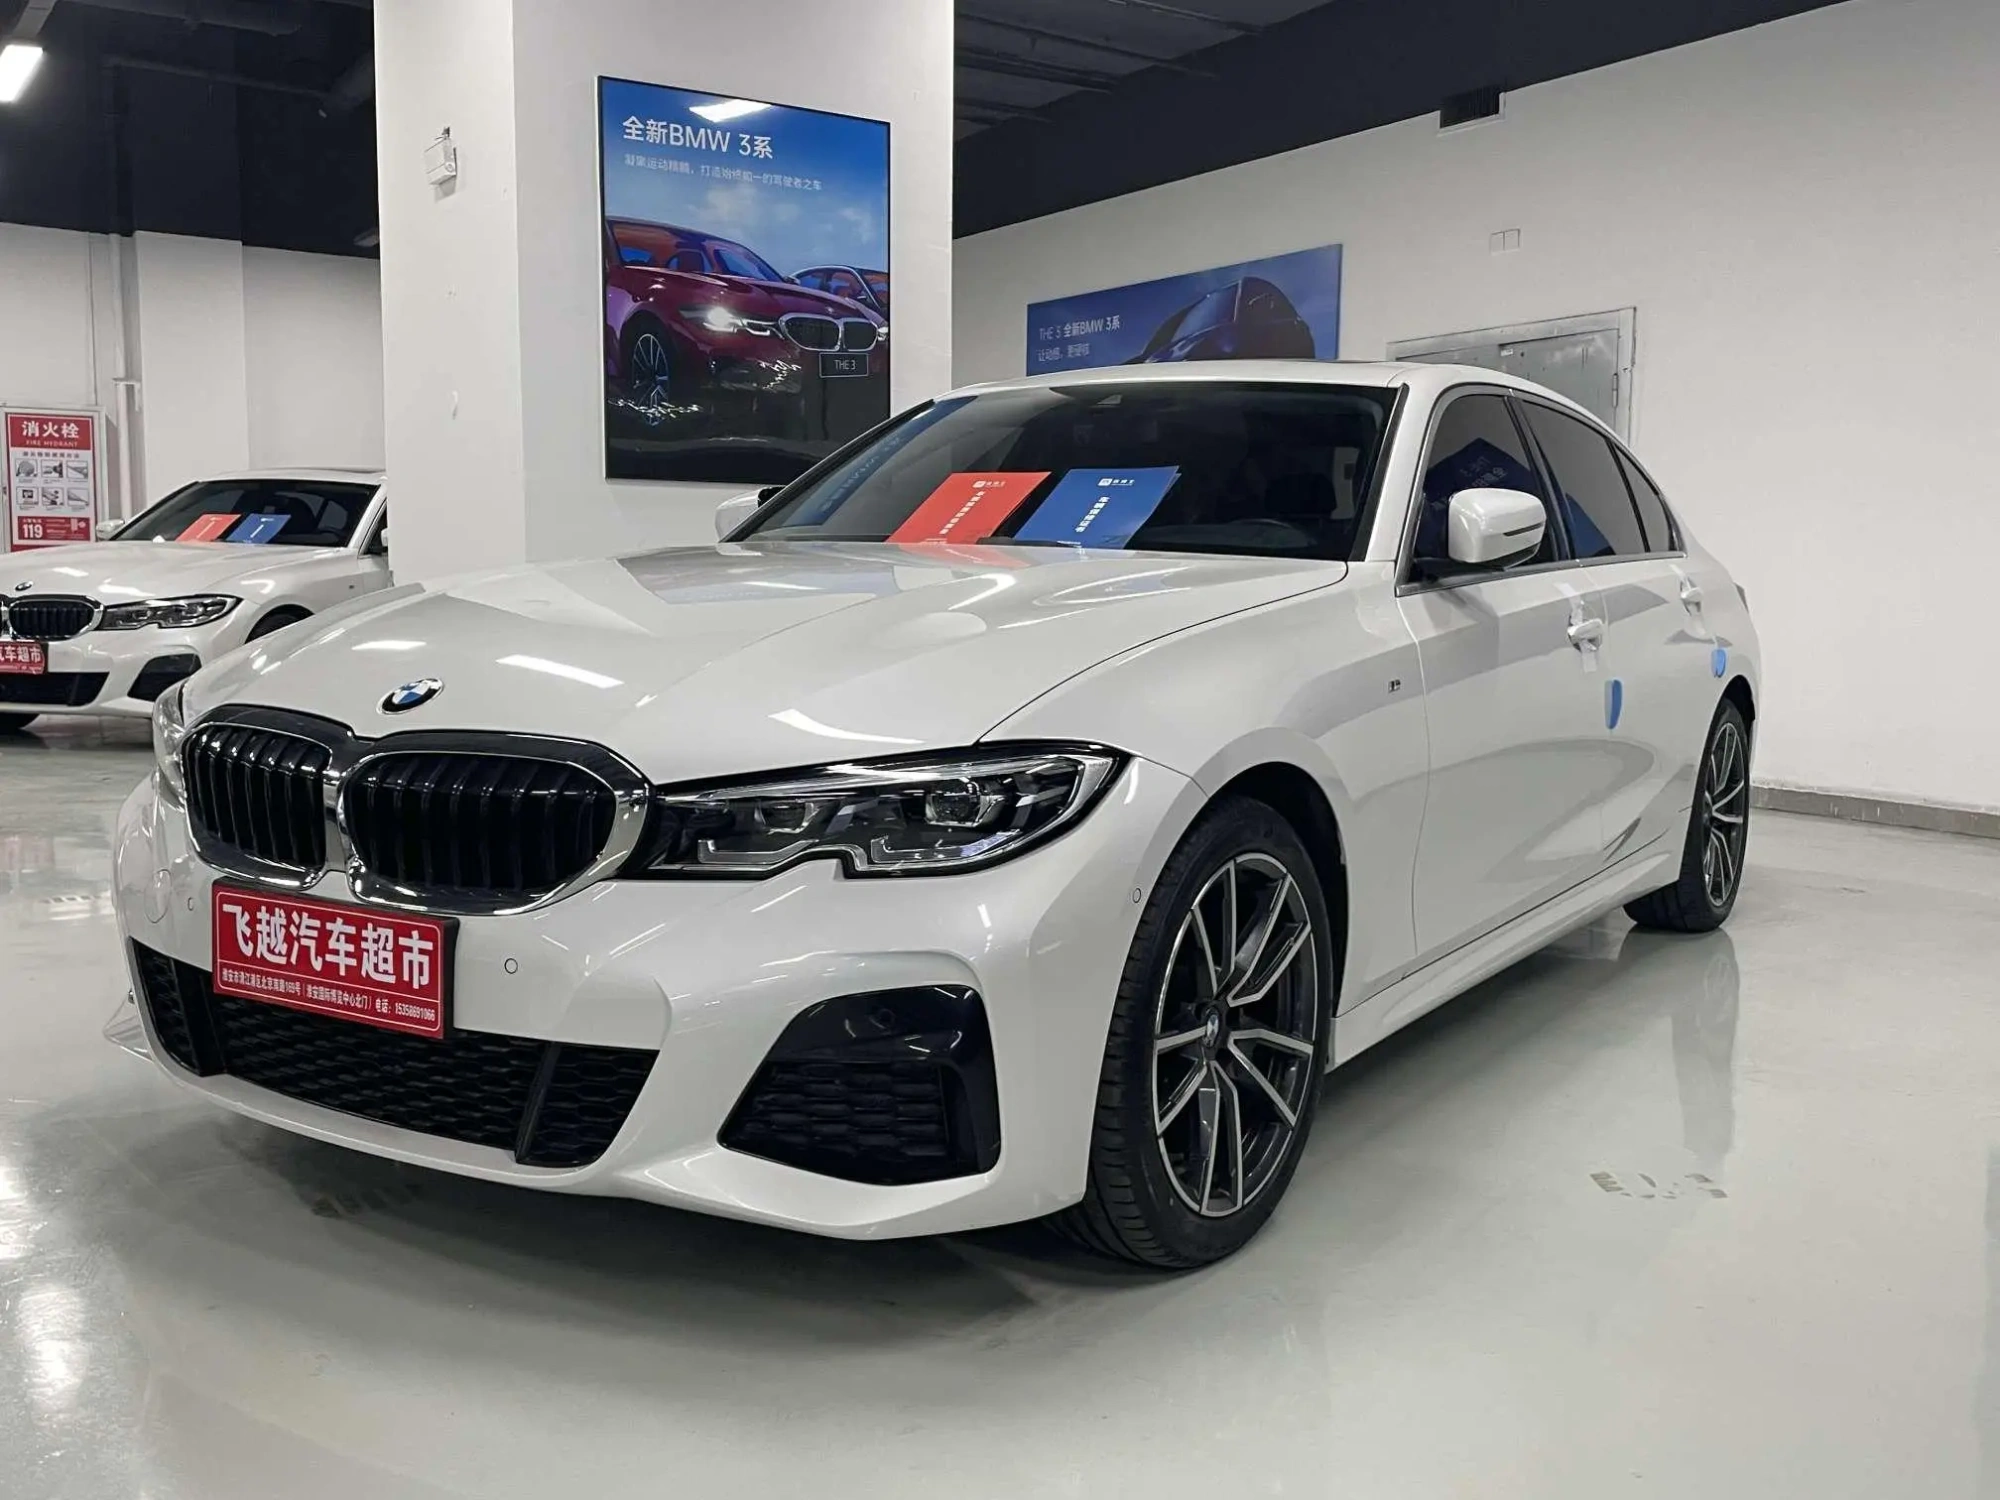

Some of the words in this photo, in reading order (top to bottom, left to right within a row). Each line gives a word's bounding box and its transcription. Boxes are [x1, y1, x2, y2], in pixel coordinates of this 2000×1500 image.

[622, 115, 731, 153] 全新BMW
[738, 133, 773, 159] 3系
[1063, 317, 1104, 338] 全新BMW
[1105, 315, 1120, 331] 3系
[834, 360, 850, 370] THE
[22, 421, 79, 439] 消火栓
[23, 524, 43, 539] 119
[222, 903, 434, 990] 飞越汽车超市
